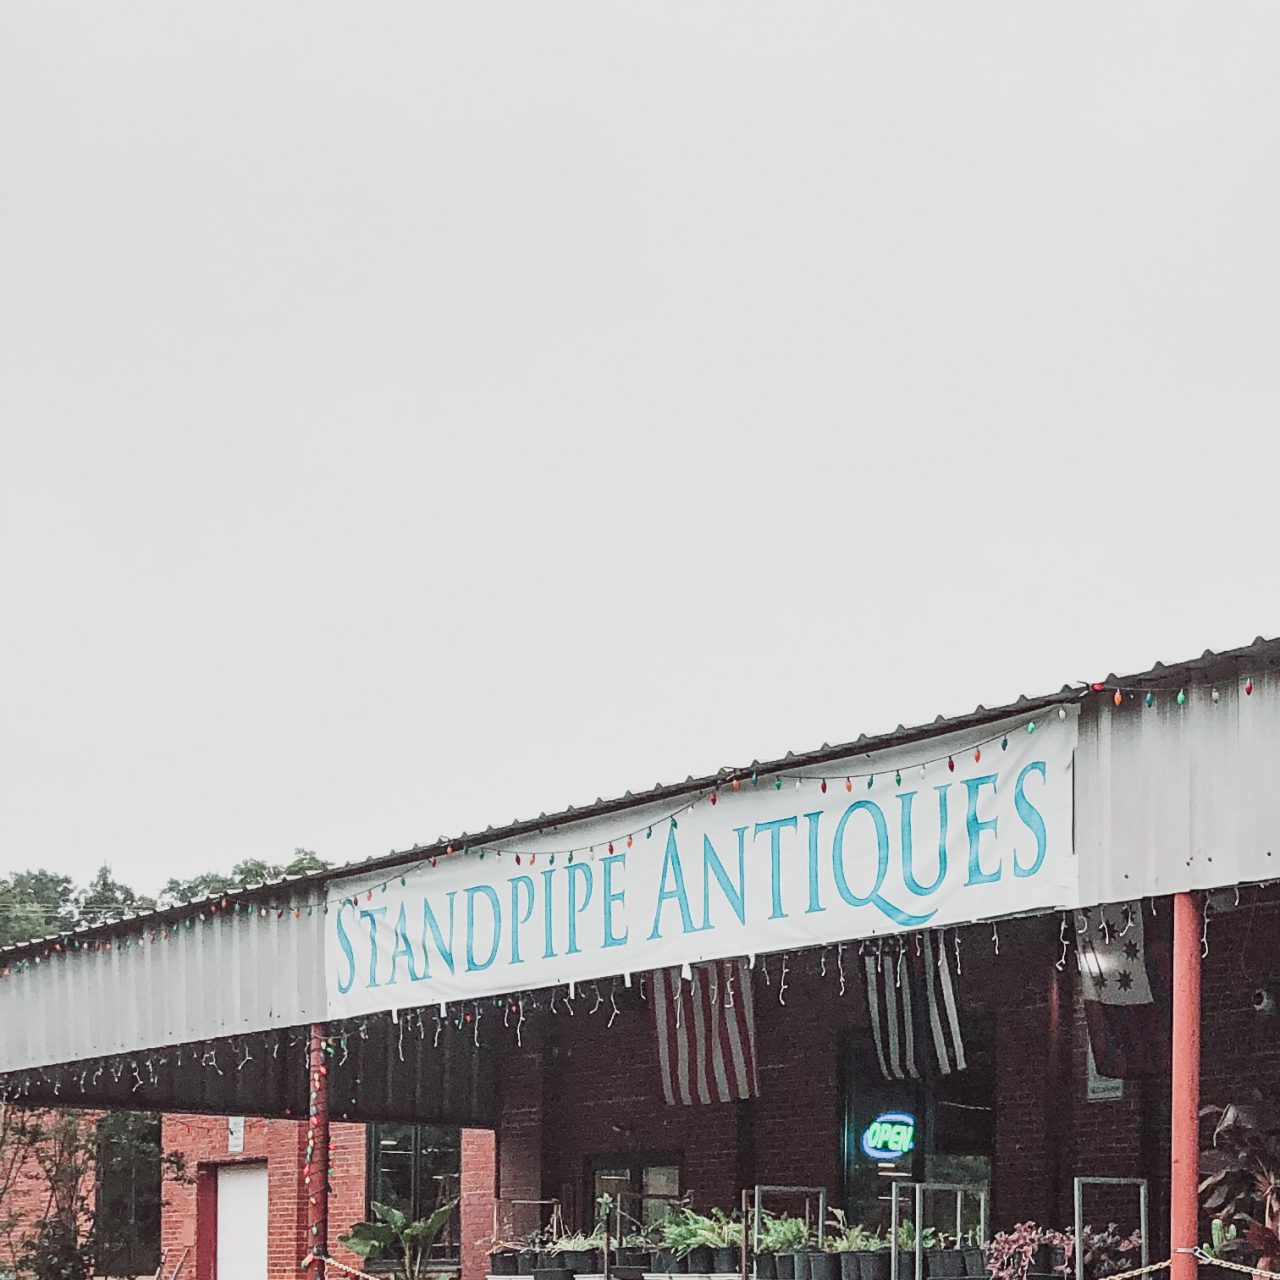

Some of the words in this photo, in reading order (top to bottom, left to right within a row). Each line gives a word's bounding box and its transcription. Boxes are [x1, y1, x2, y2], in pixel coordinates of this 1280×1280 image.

[336, 852, 629, 995] STANDPIPE
[646, 760, 1048, 941] ANTIQUES
[867, 1122, 914, 1152] OPEN
